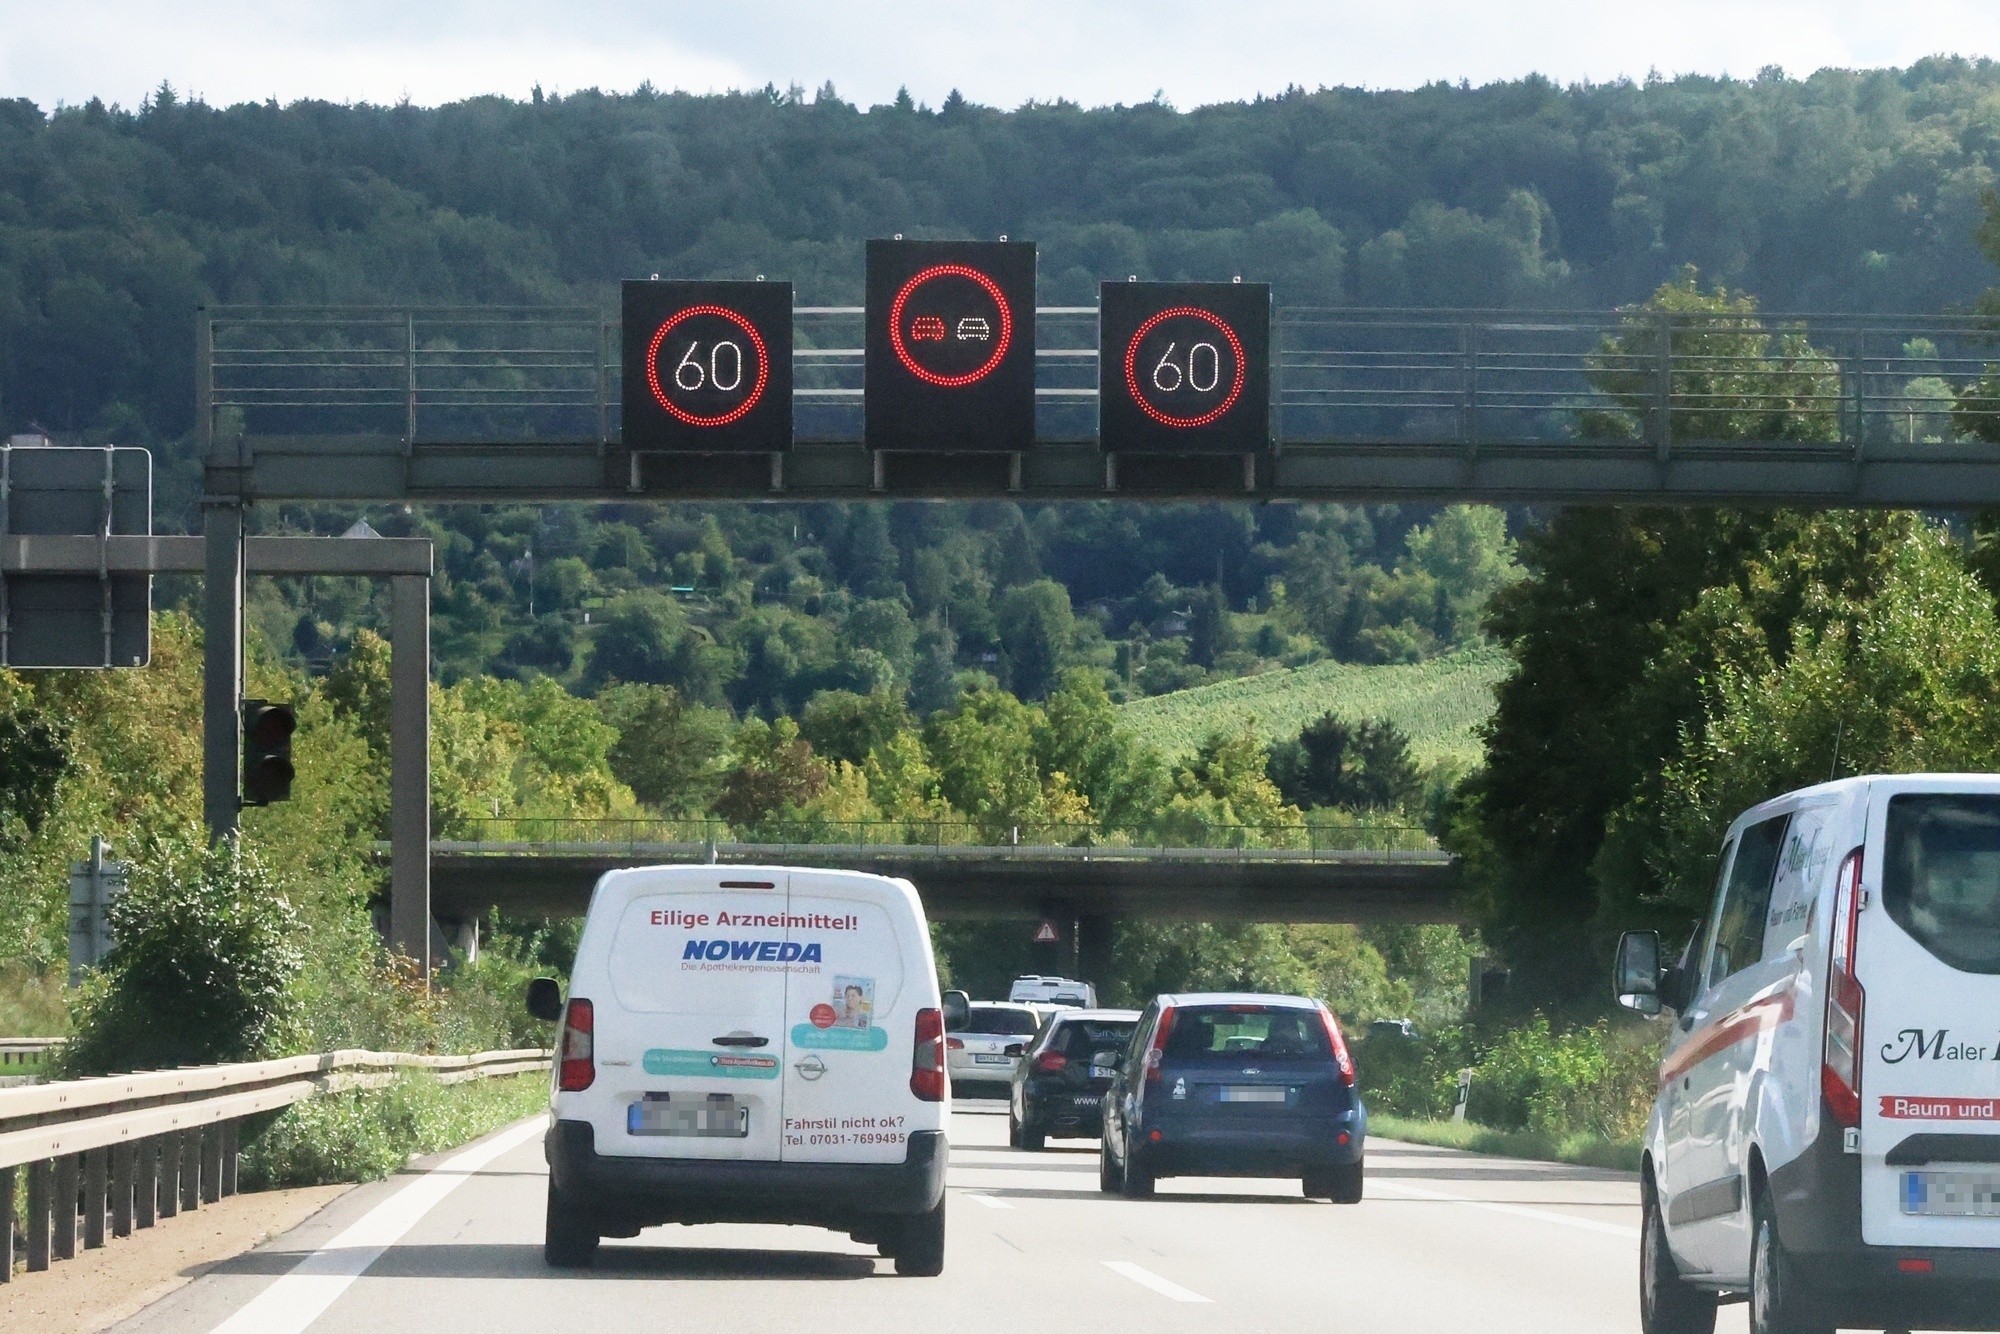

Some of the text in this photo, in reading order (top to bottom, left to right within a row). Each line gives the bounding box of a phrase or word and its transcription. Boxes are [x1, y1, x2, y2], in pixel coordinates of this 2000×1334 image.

[676, 341, 741, 391] 60
[1153, 342, 1218, 392] 60
[651, 910, 858, 930] Eilige Arzneimittel!
[682, 940, 822, 963] NOWEDA
[681, 962, 821, 974] Die Apothekergenossenschaft
[1881, 1028, 1986, 1064] Maler
[1894, 1099, 1994, 1117] Raum und
[785, 1115, 905, 1130] Fahrstil nicht ok?
[785, 1133, 905, 1146] Tel. 07031-7699495
